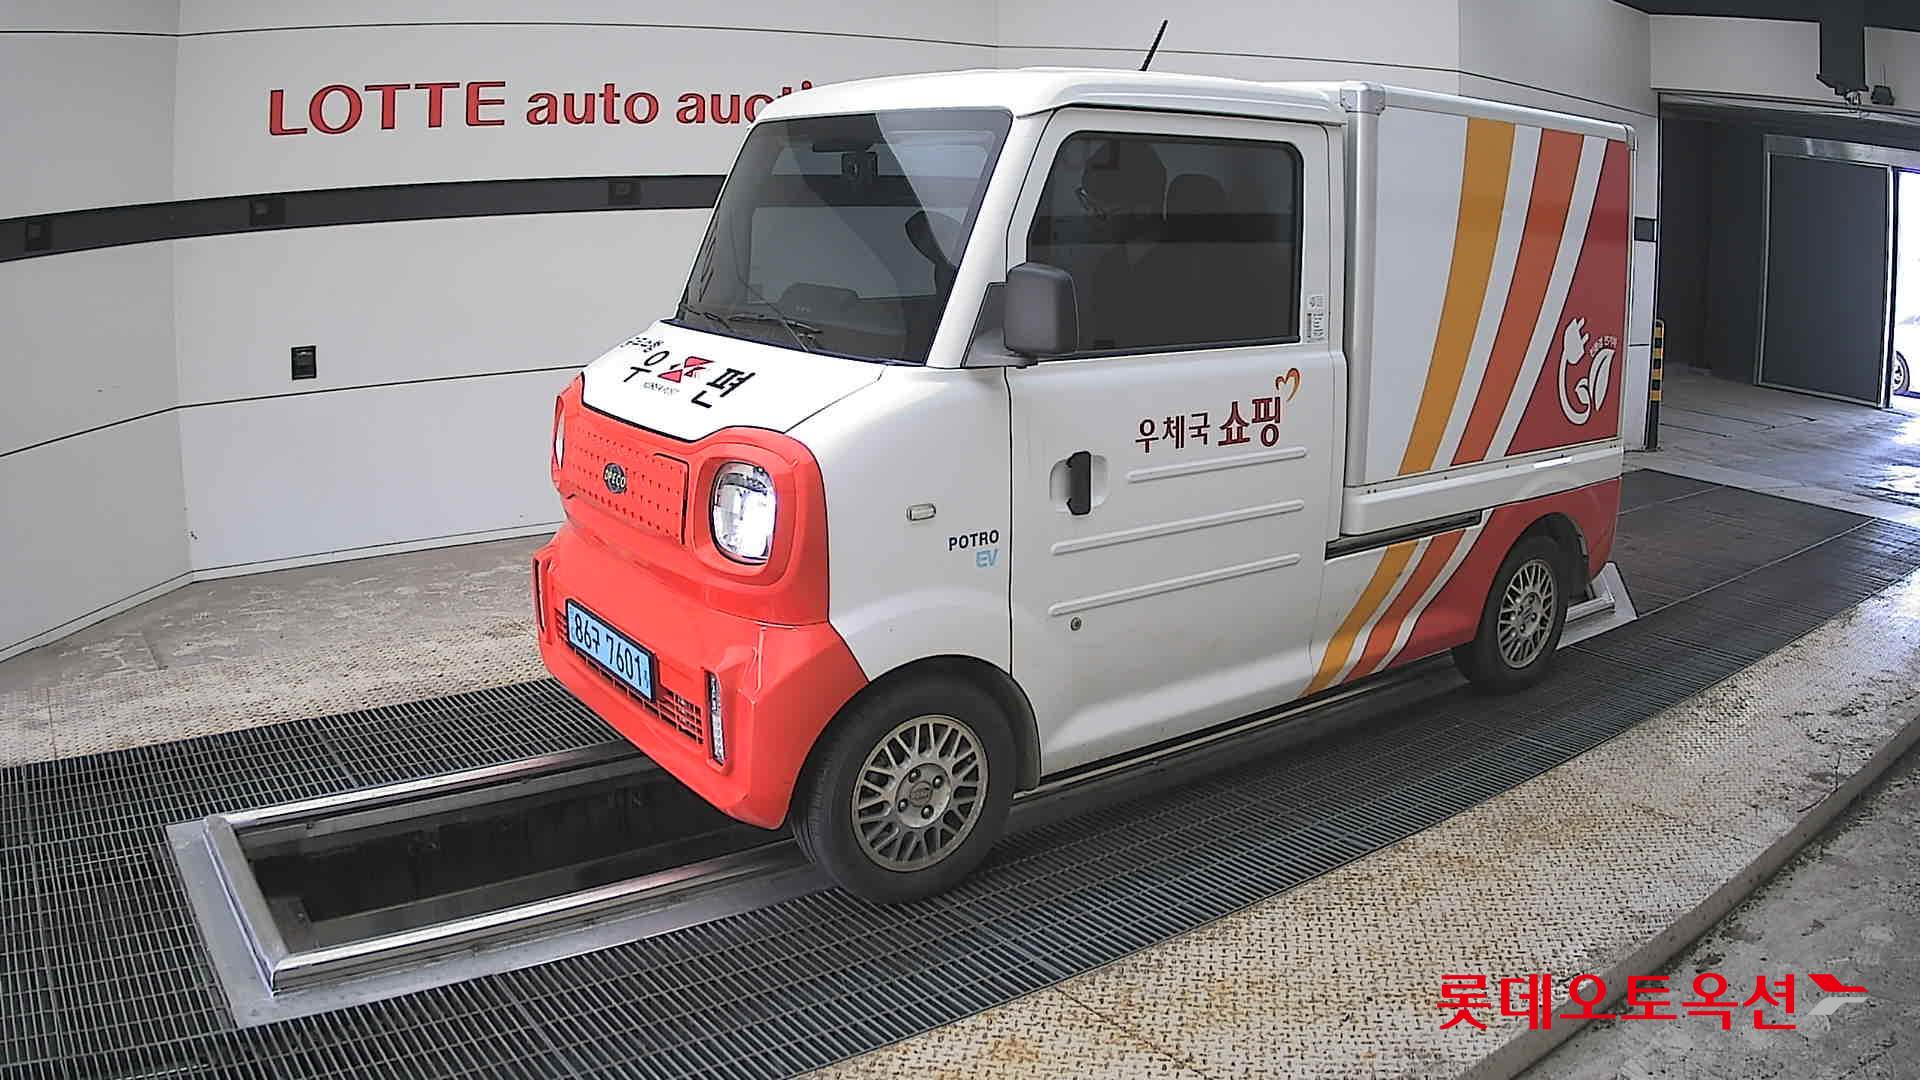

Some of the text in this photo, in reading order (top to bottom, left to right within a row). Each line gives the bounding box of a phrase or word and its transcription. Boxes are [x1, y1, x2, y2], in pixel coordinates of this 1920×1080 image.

[270, 80, 812, 136] LOTTE auto auc
[1135, 396, 1281, 453] 우체국 쇼핑
[948, 529, 999, 551] POTRO
[976, 548, 998, 568] EV
[606, 633, 642, 687] 7601
